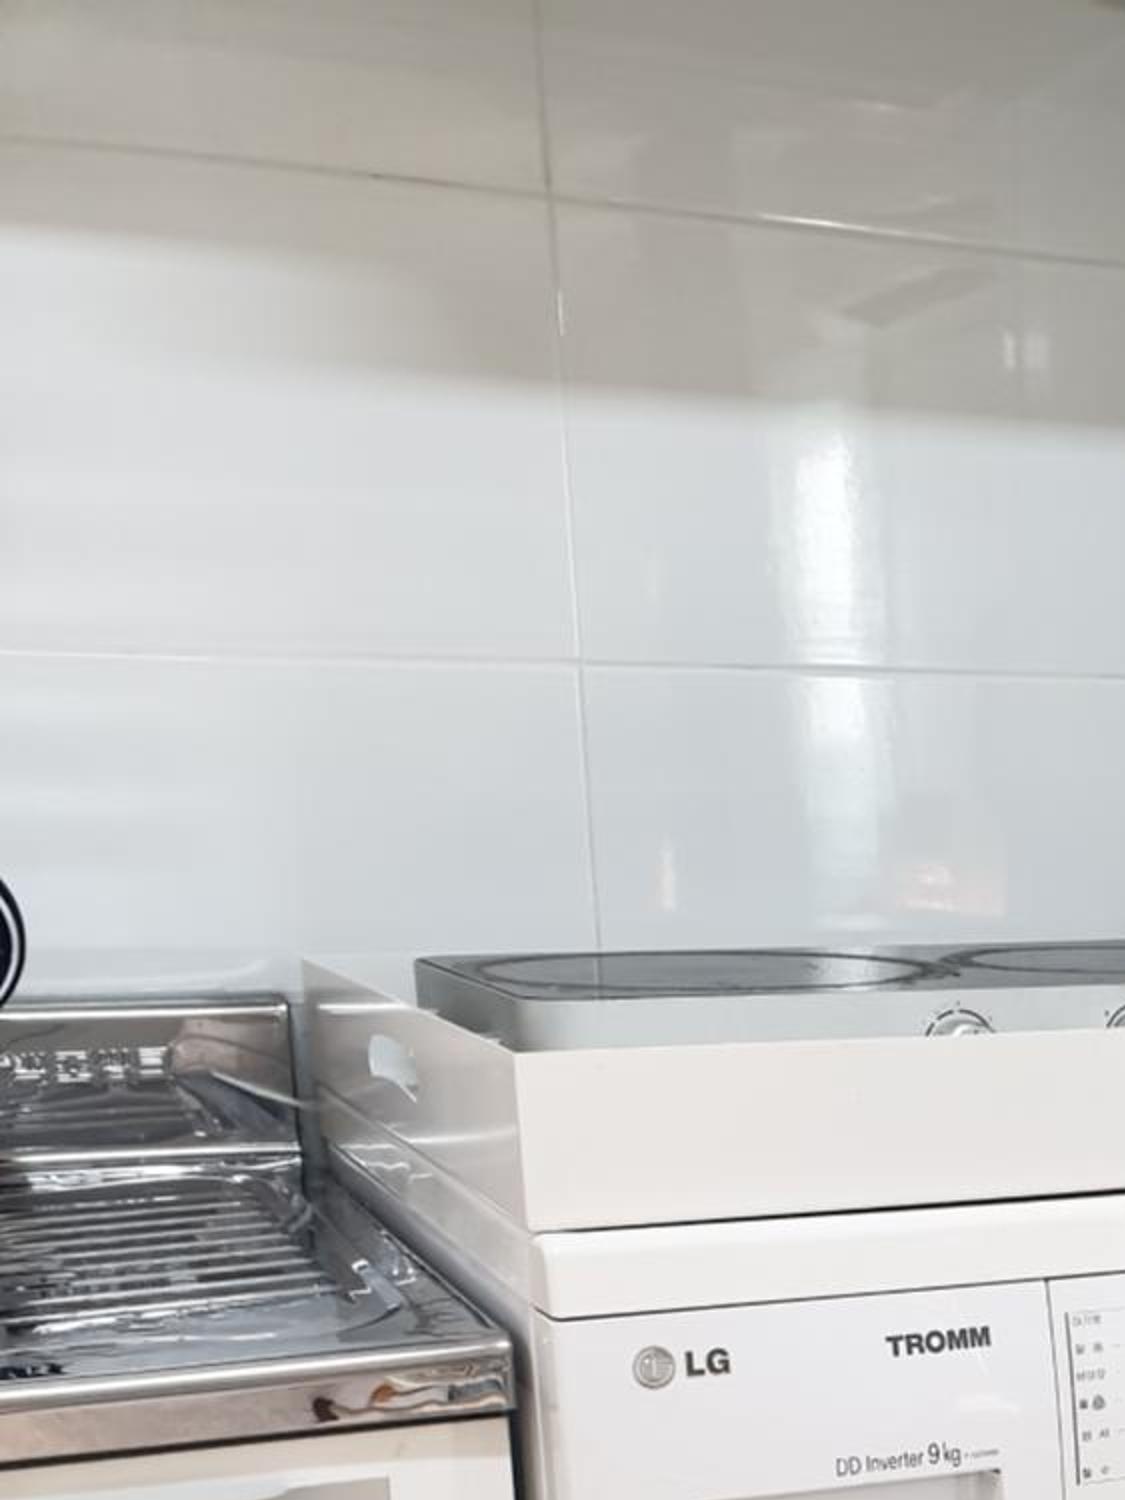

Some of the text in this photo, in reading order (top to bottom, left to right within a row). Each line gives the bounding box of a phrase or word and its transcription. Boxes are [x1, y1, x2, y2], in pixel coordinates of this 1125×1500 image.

[886, 1326, 992, 1357] TROMM
[685, 1348, 731, 1377] LG
[835, 1455, 862, 1477] DD
[865, 1451, 924, 1473] Inverter
